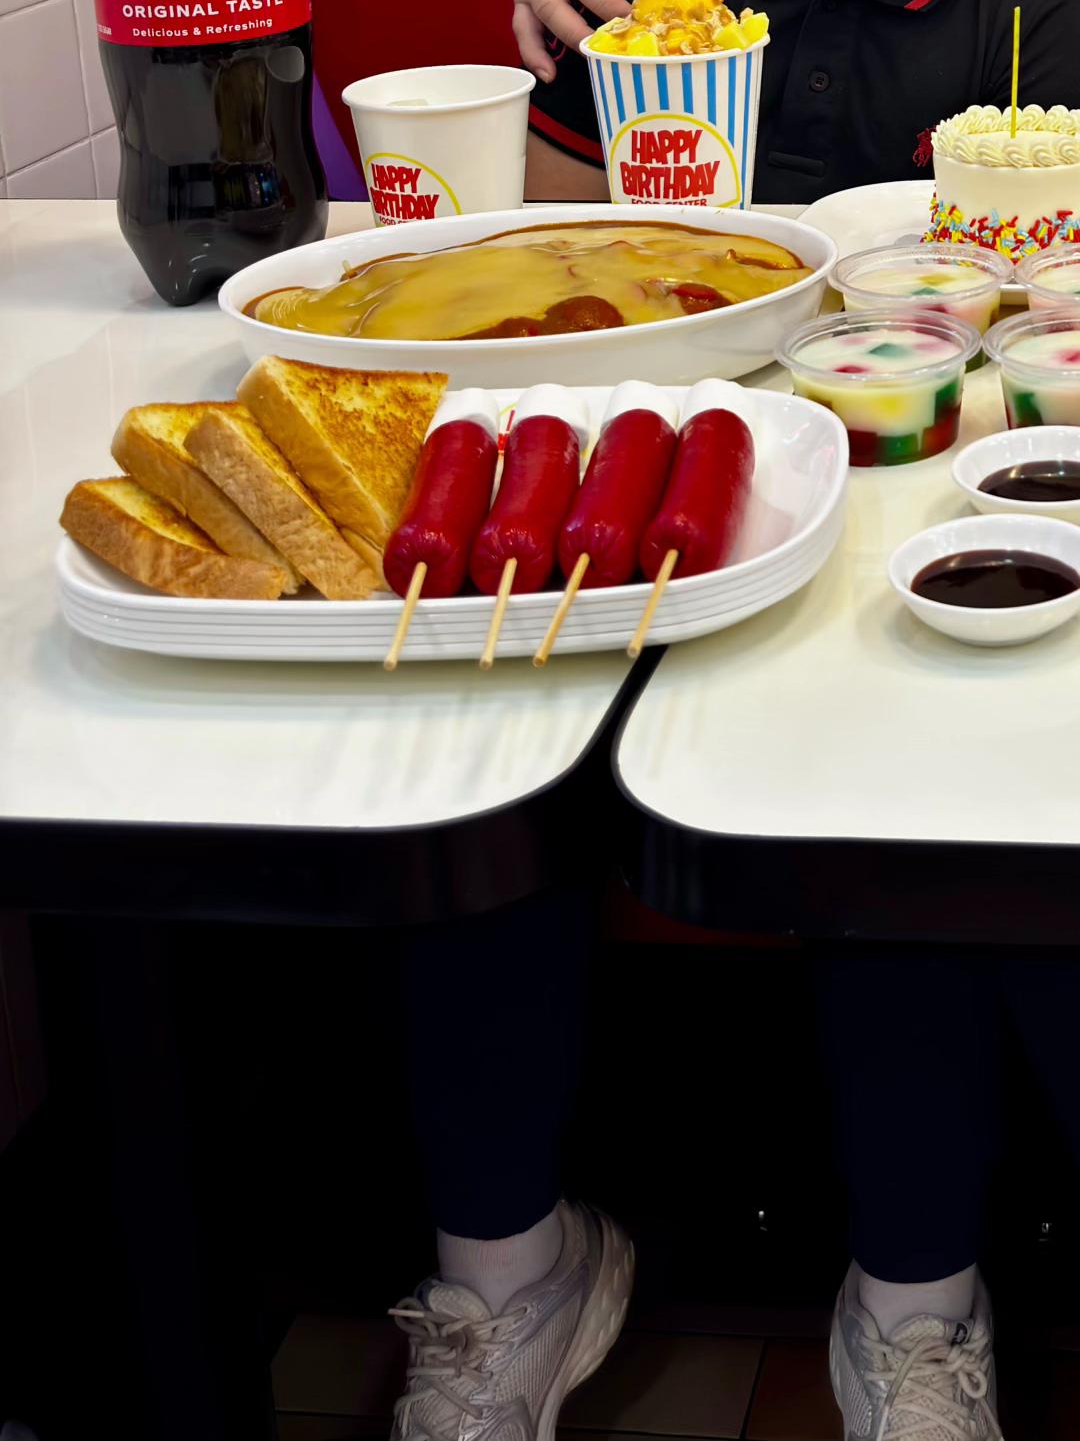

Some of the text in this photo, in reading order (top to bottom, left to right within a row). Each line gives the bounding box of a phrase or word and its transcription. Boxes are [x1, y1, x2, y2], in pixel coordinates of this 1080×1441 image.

[122, 3, 219, 19] ORIGINAL
[132, 18, 273, 38] Delicious & Refreshing
[631, 129, 703, 165] HAPPY
[371, 163, 422, 194] HAPPY
[620, 160, 720, 199] BIRTHDAY
[370, 187, 440, 220] BIRTHDAY
